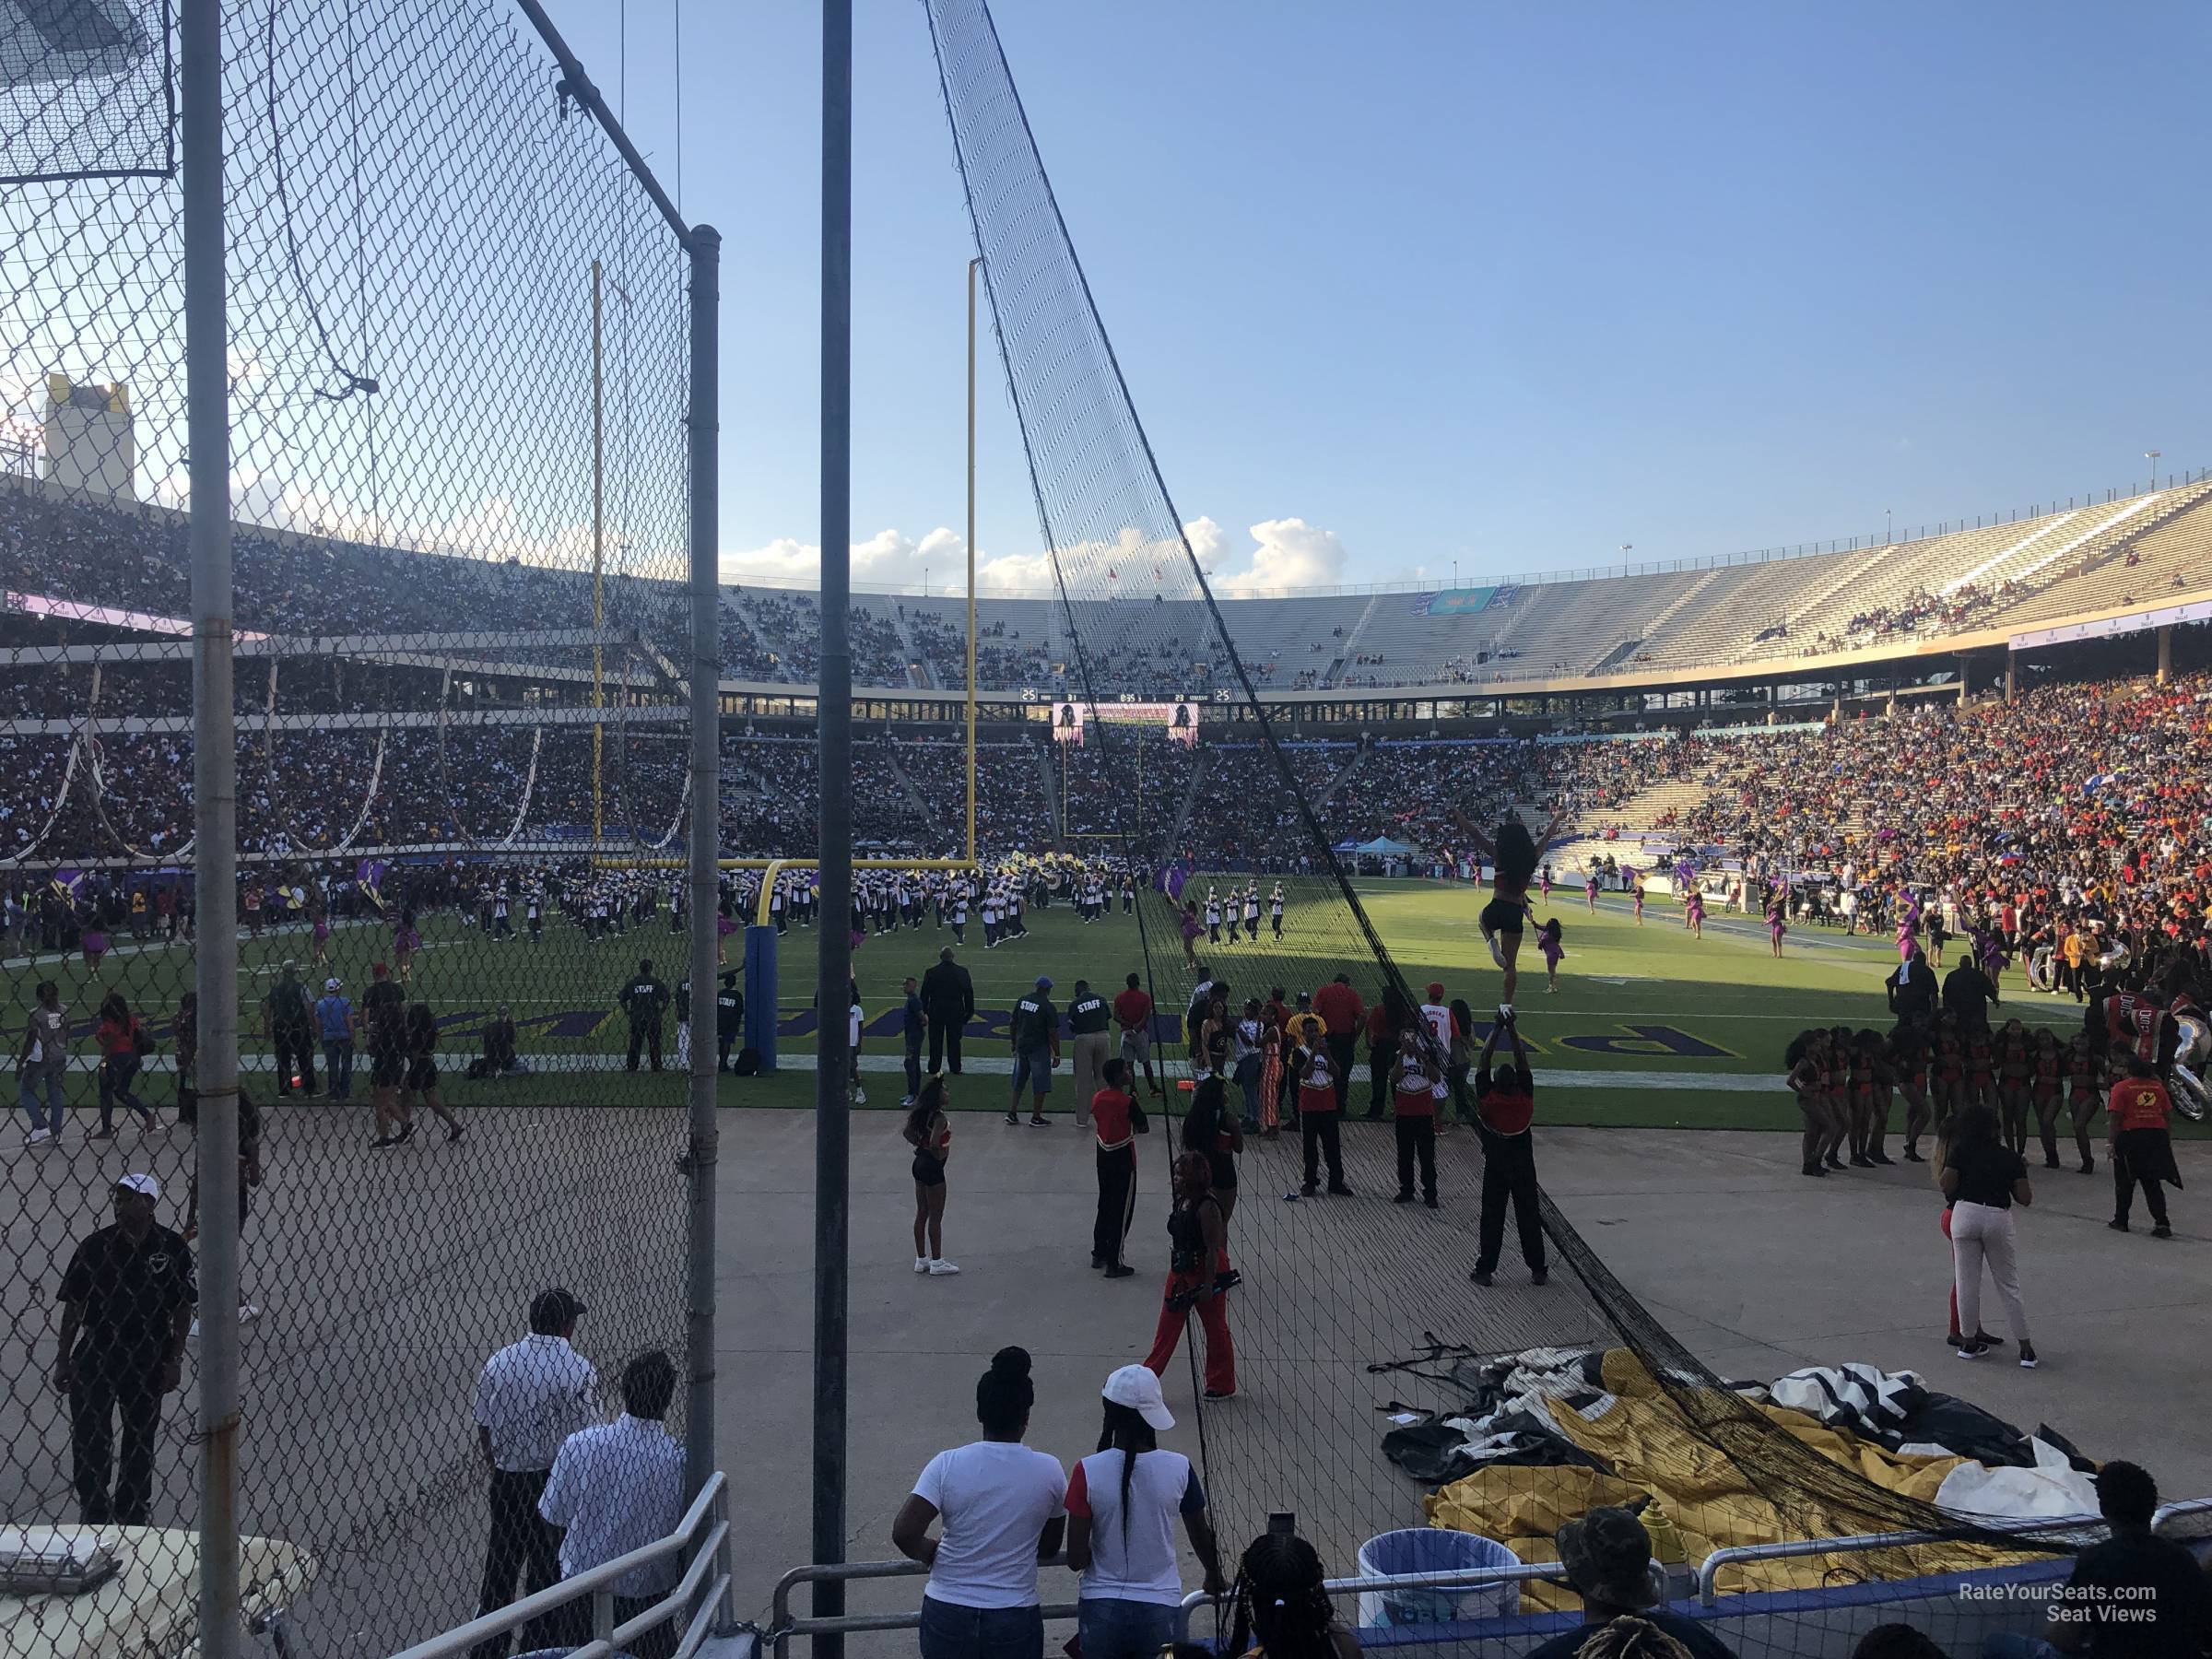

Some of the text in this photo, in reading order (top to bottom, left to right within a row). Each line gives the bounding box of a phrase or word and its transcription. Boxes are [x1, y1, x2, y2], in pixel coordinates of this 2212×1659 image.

[1022, 689, 1035, 700] 25
[1217, 690, 1230, 700] 25
[634, 984, 653, 994] STAFF
[719, 997, 735, 1007] STAFF
[1019, 1000, 1040, 1014] STAFF
[1077, 999, 1101, 1014] STAFF
